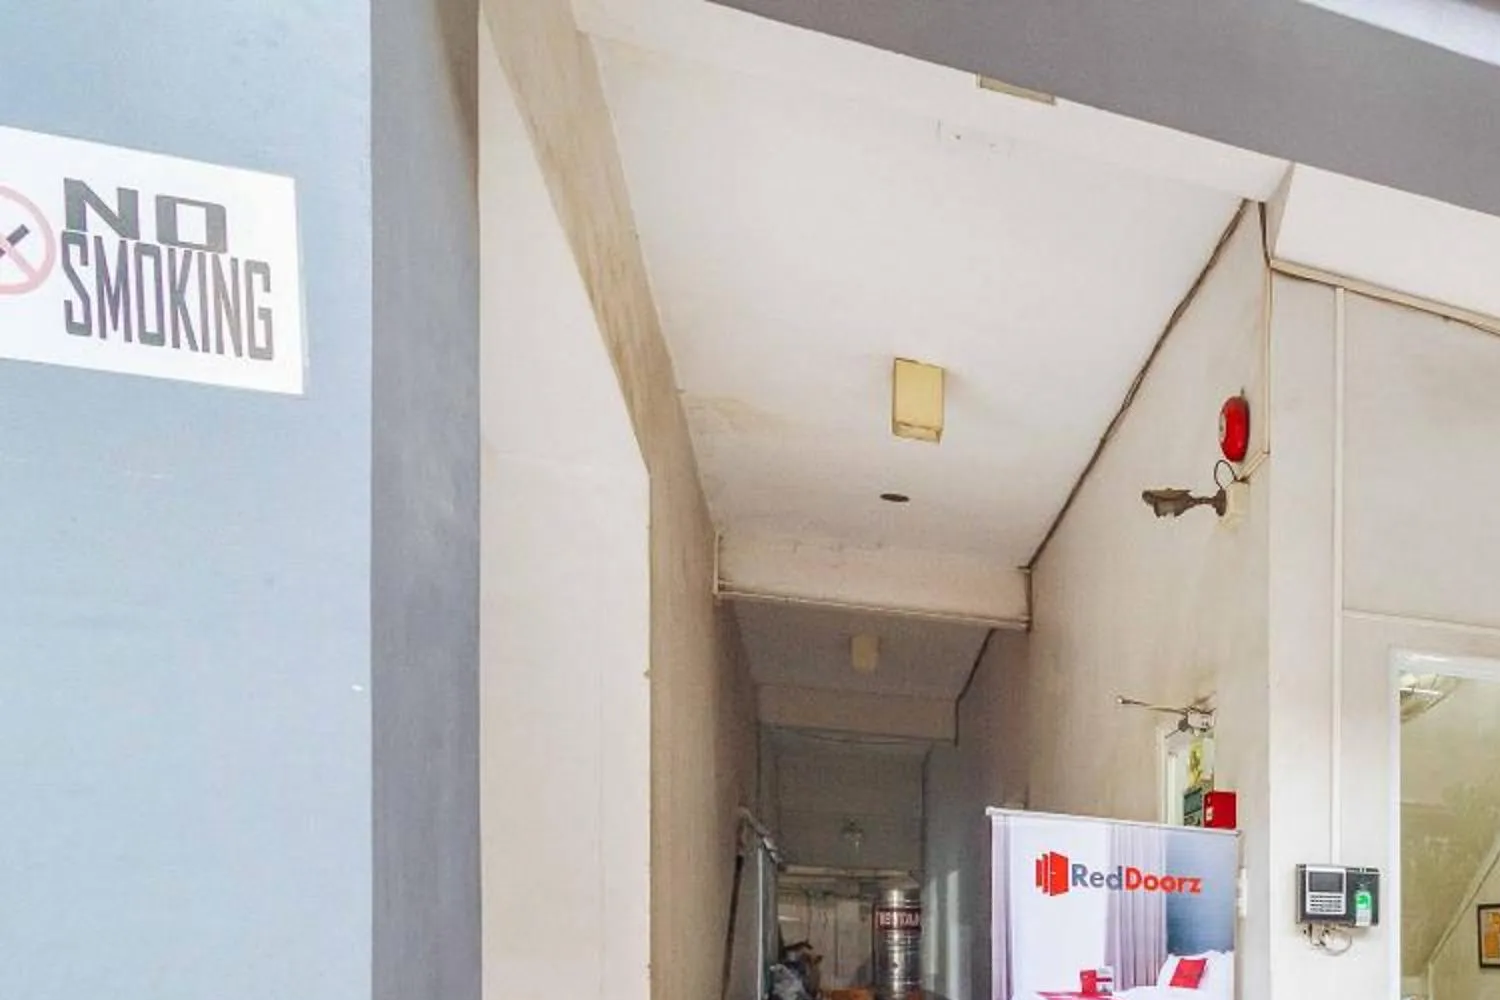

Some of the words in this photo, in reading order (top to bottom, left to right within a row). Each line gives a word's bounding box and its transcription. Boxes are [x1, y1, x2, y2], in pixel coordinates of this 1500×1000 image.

[63, 177, 228, 254] NO
[61, 230, 274, 361] SMOKING
[1071, 863, 1203, 894] RedDoorz
